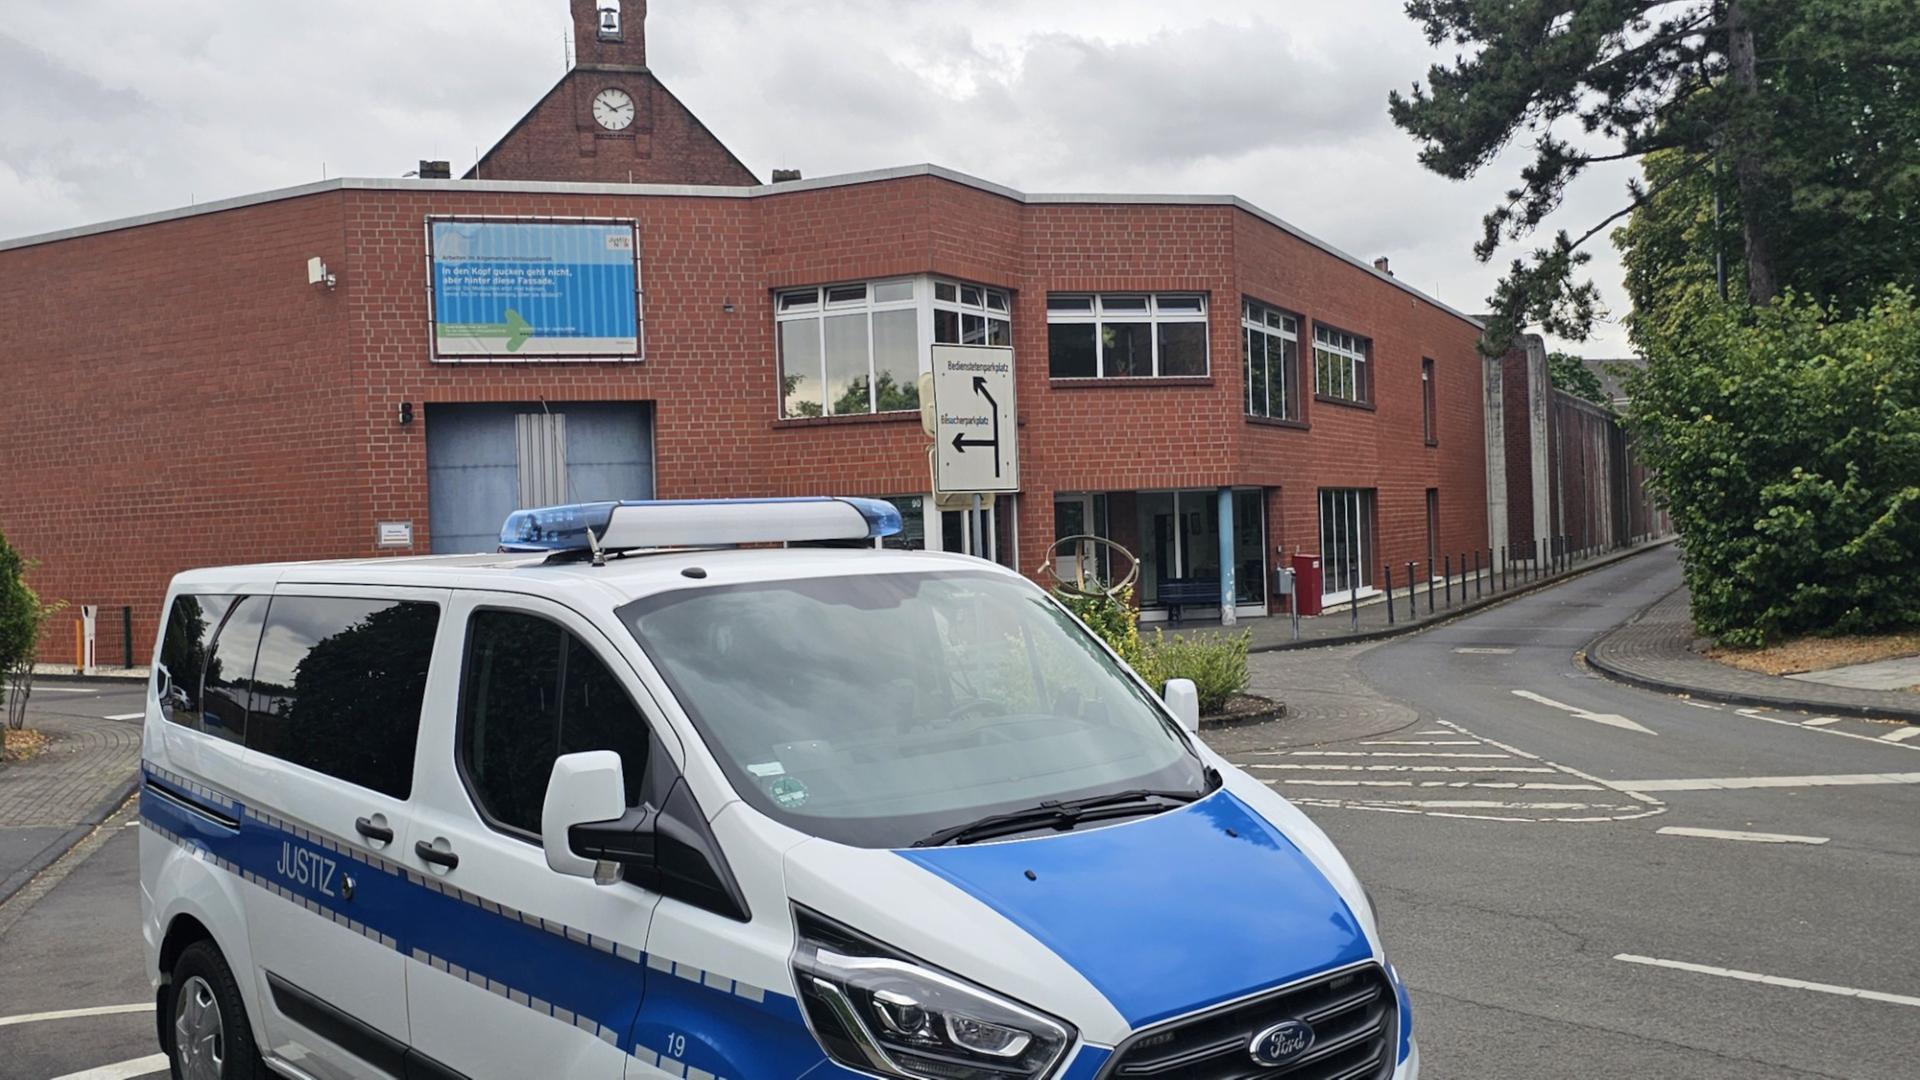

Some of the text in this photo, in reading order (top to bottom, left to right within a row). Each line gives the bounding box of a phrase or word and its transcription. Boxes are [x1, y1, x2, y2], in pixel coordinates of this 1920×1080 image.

[442, 267, 573, 278] In den Kopf gucken geht nicht,
[442, 276, 556, 286] aber hinter diese Fassade.
[948, 361, 1008, 373] Bedienstetenparkplatz
[941, 414, 989, 427] Besucherparkplatz
[277, 841, 337, 897] JUSTIZ
[668, 1032, 686, 1058] 19
[1270, 1028, 1305, 1058] Ford
